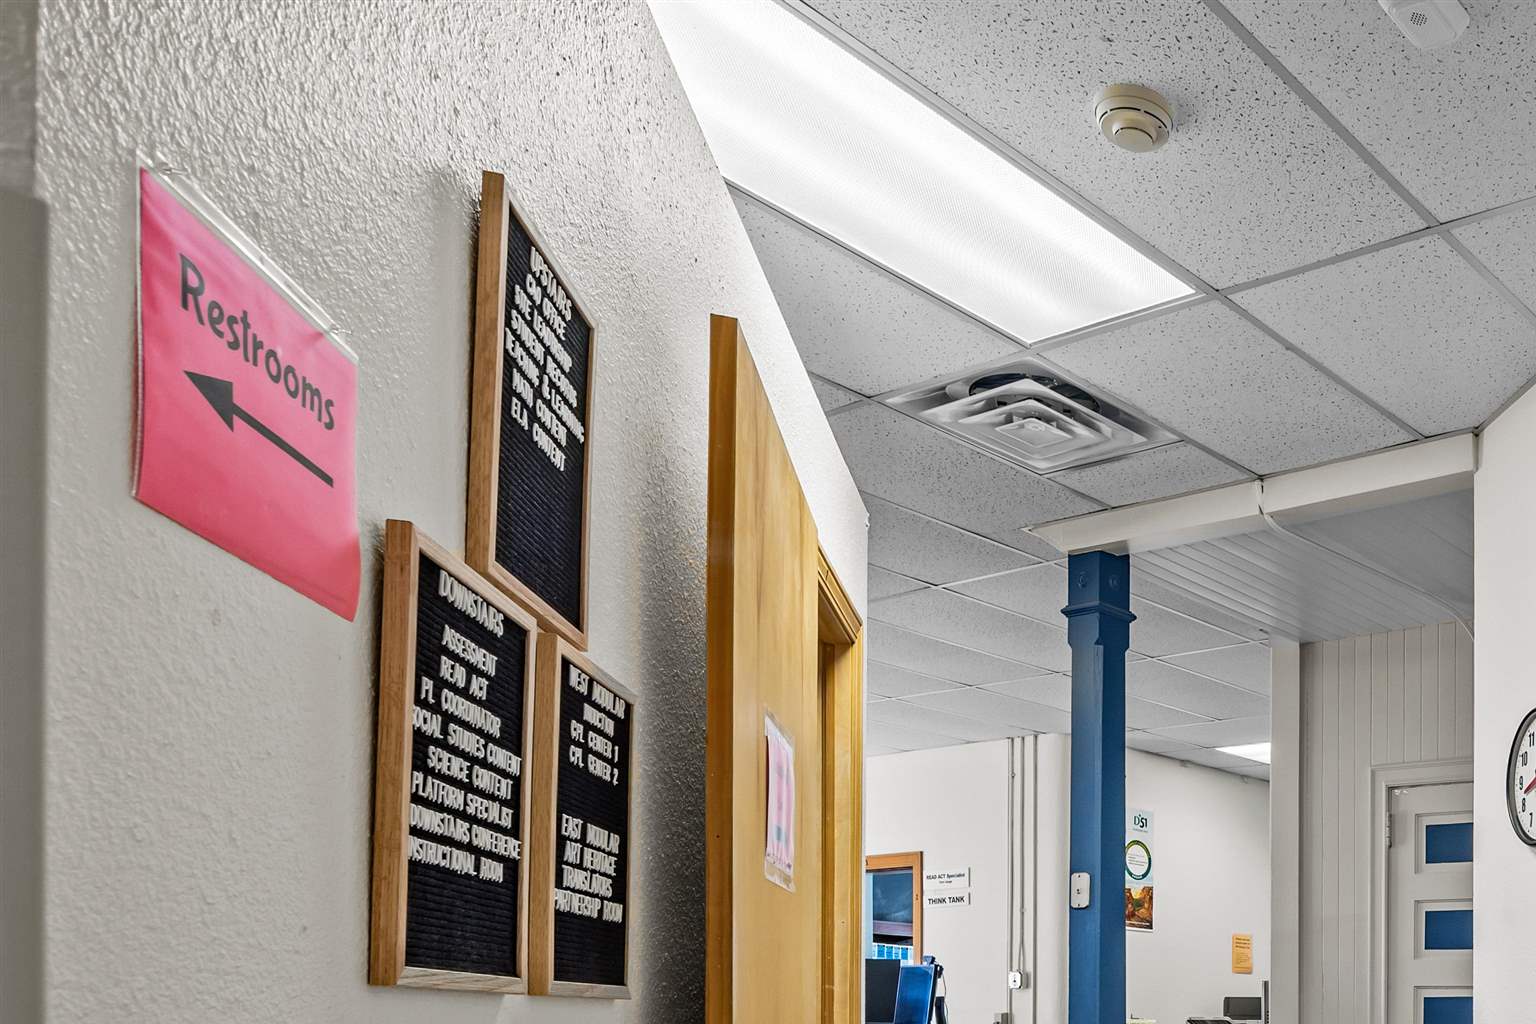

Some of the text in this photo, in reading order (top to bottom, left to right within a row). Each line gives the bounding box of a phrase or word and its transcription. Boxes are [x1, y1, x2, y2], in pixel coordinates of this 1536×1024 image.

[514, 284, 533, 321] SITE
[530, 246, 573, 322] UPSTAIRS
[510, 309, 546, 365] STUDENT
[542, 297, 567, 340] OFFICE
[180, 253, 335, 430] Restrooms
[542, 374, 551, 400] &
[511, 396, 567, 472] ELA CONTENT
[535, 399, 568, 447] CONTENT
[439, 569, 504, 638] DOWNSTAIRS
[441, 624, 498, 677] ASSESSMENT
[440, 655, 488, 700] READ ACT
[568, 664, 590, 696] WEST
[420, 676, 501, 738] PL COORDINATOR
[447, 723, 486, 759] STUDIES
[486, 743, 522, 776] CONTENT
[588, 731, 613, 759] CENTER
[614, 745, 619, 763] 1
[1520, 751, 1528, 768] 10
[1528, 731, 1536, 748] 11
[427, 746, 513, 800] SCIENCE CONTENT
[588, 753, 612, 782] CENTER
[613, 767, 619, 786] 2
[1519, 775, 1524, 791] 9
[411, 771, 514, 829] PLATFORM SPECIALIST
[1521, 797, 1527, 813] 8
[1529, 811, 1533, 828] 7
[410, 803, 522, 860] DOWNSTAIRS CONFERENCE
[561, 813, 620, 854] EAST MODULAR
[480, 856, 503, 883] ROOM
[564, 840, 618, 876] ART HERITAGE
[603, 900, 624, 924] ROOM
[928, 897, 946, 905] THINK
[948, 896, 964, 904] TANK
